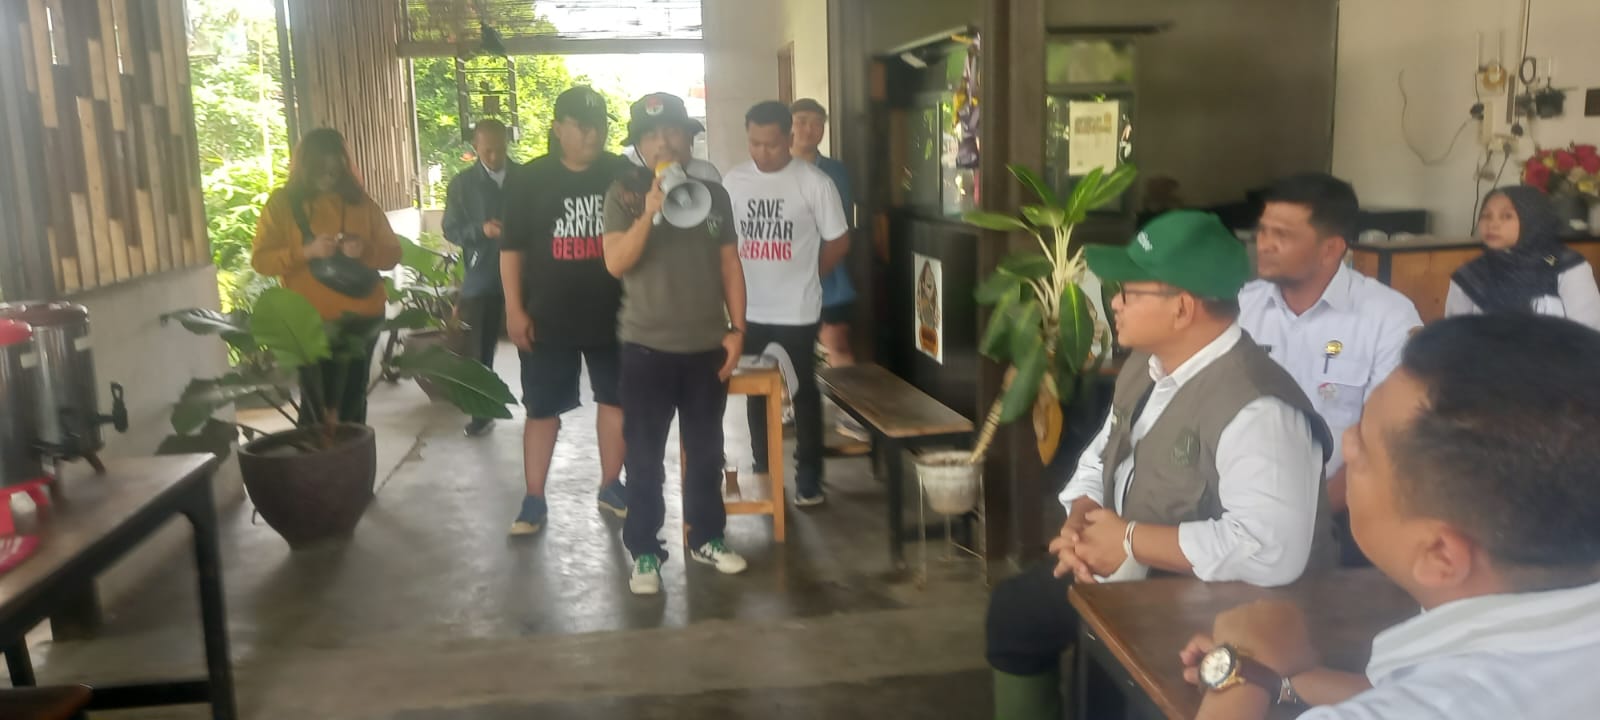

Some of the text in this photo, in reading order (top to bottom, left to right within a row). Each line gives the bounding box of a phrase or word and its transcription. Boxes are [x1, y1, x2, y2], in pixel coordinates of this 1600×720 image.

[563, 194, 603, 220] SAVE
[747, 198, 784, 219] SAVE
[553, 216, 604, 238] BANTA
[552, 235, 603, 260] GEBA
